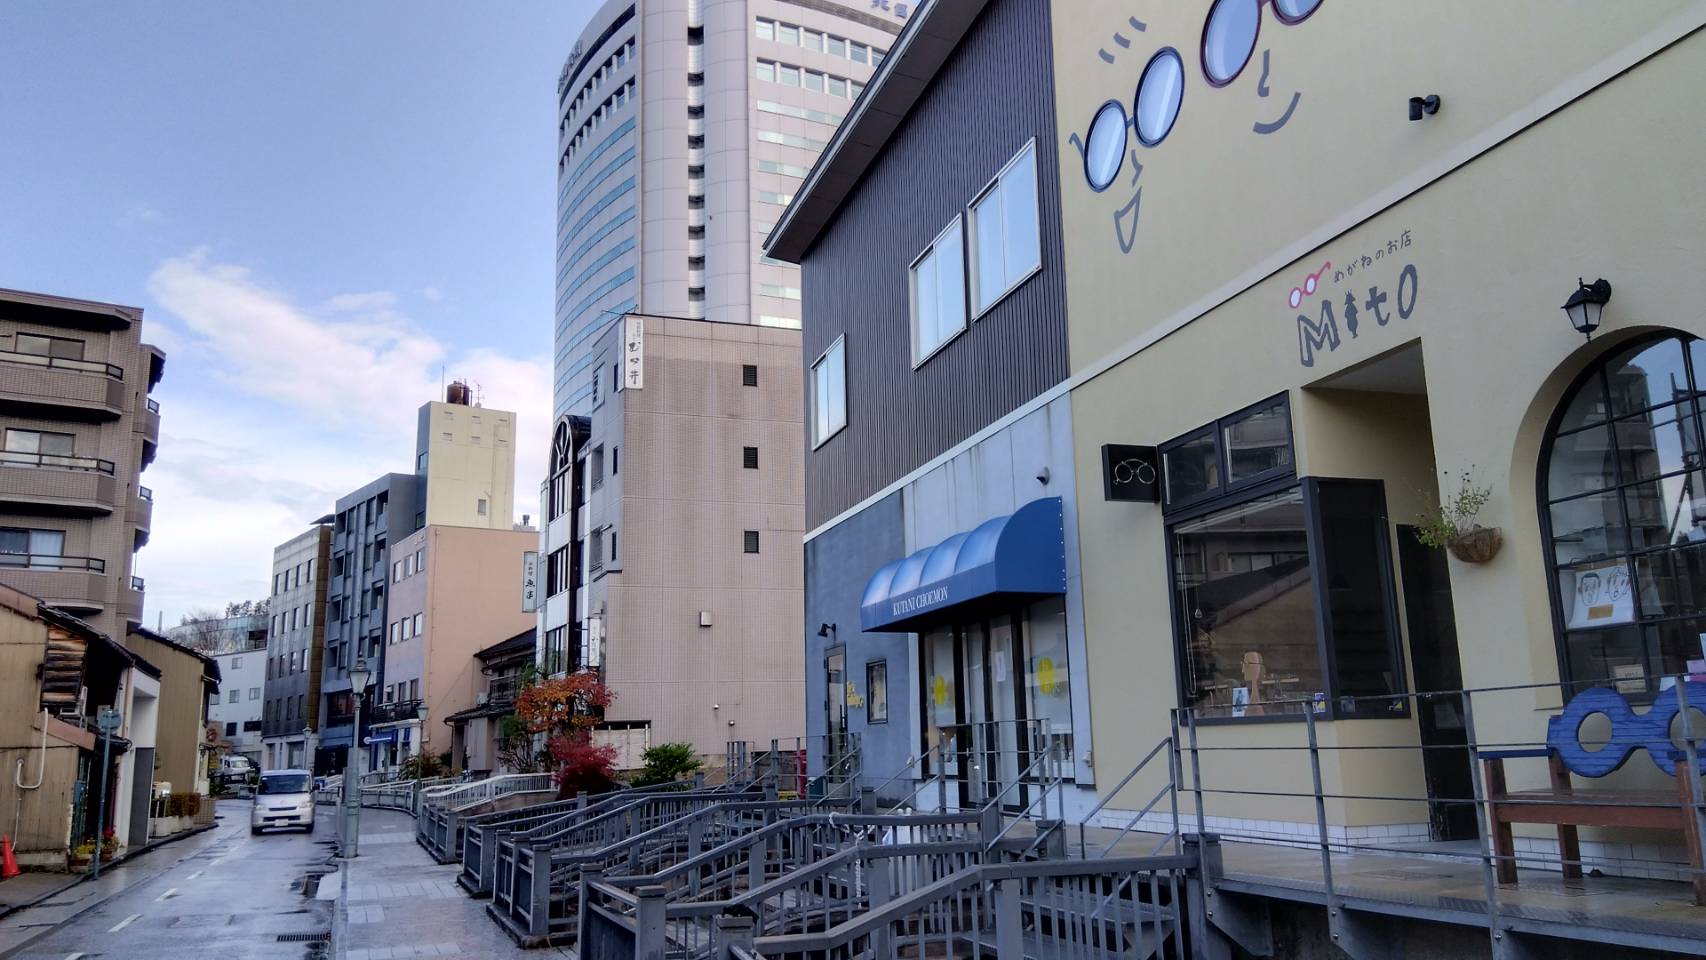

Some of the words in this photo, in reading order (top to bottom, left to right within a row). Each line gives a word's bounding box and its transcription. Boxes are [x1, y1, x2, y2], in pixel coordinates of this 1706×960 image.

[1334, 229, 1412, 284] めがねのお店
[893, 597, 915, 616] KUTANI
[916, 586, 948, 608] CHOEMON
